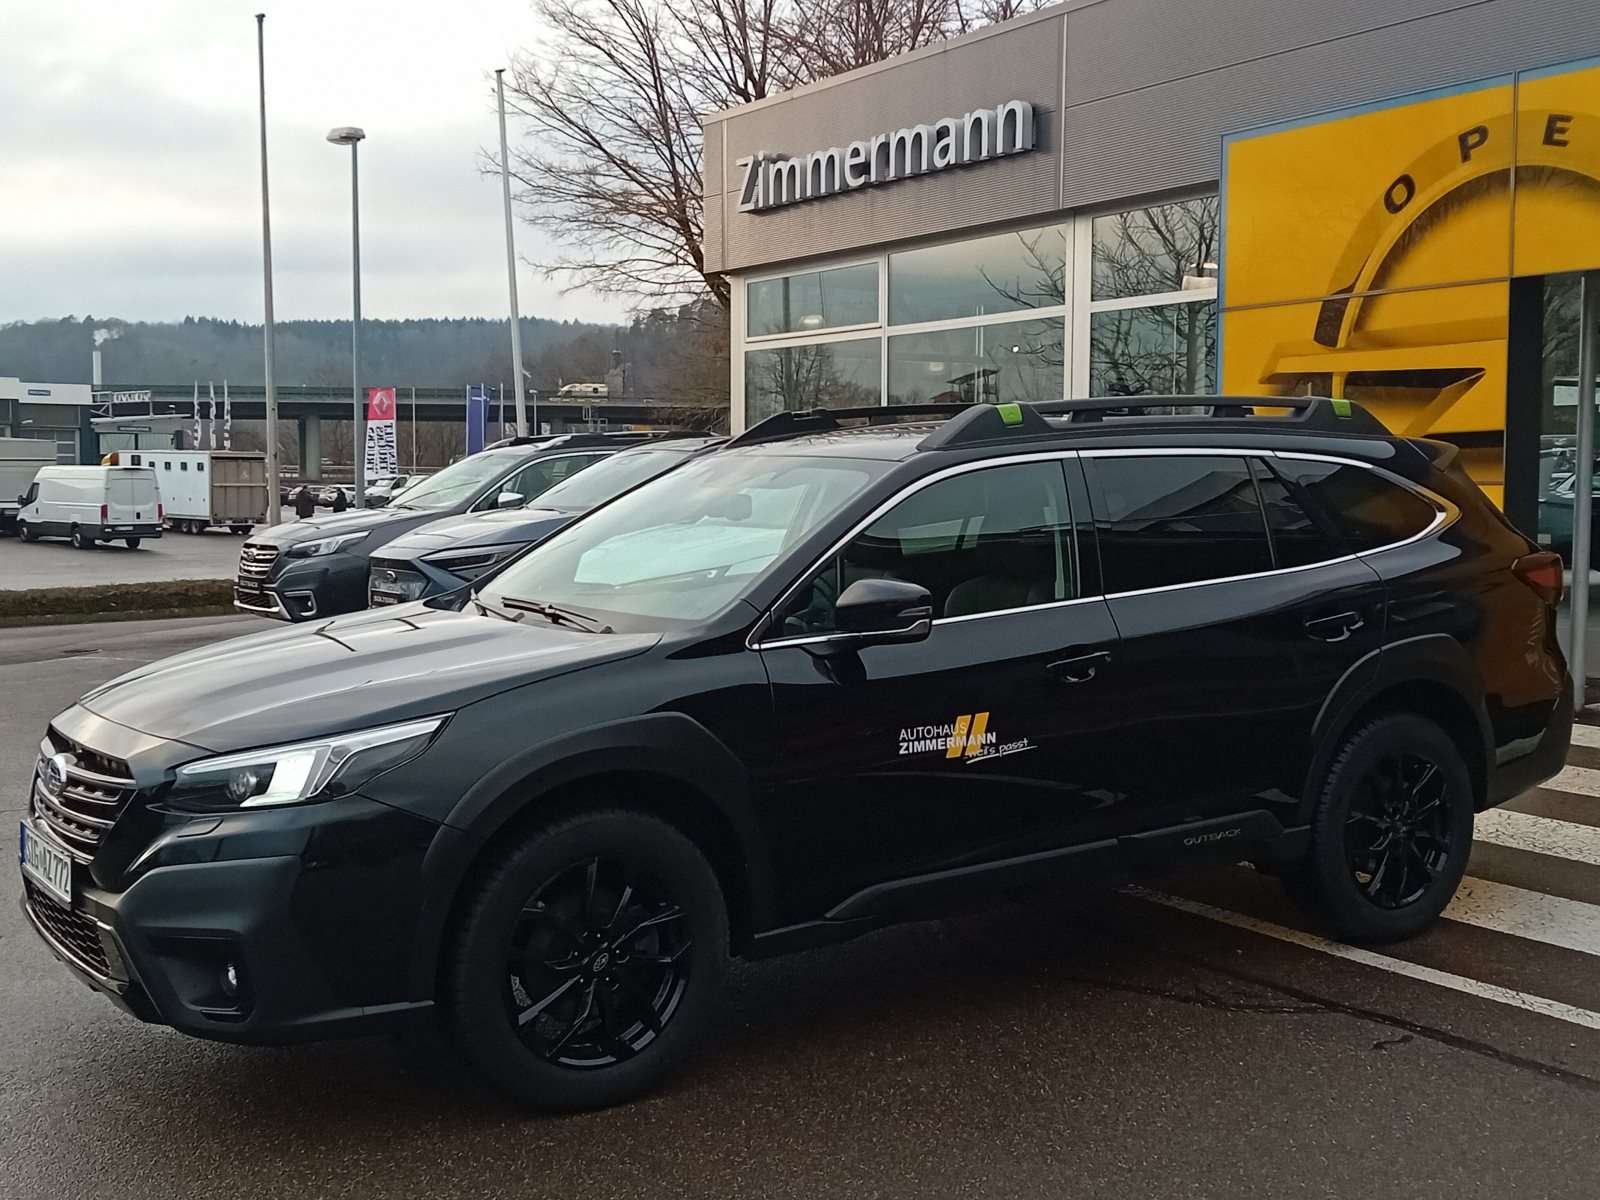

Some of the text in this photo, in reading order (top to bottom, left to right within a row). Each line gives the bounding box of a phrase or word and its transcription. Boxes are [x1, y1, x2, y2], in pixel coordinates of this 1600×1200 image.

[736, 99, 1033, 213] Zimmermann
[1384, 114, 1574, 214] OPE
[899, 722, 968, 741] AUTOHAUS
[899, 732, 997, 755] ZIMMERMANN
[999, 737, 1029, 757] passt
